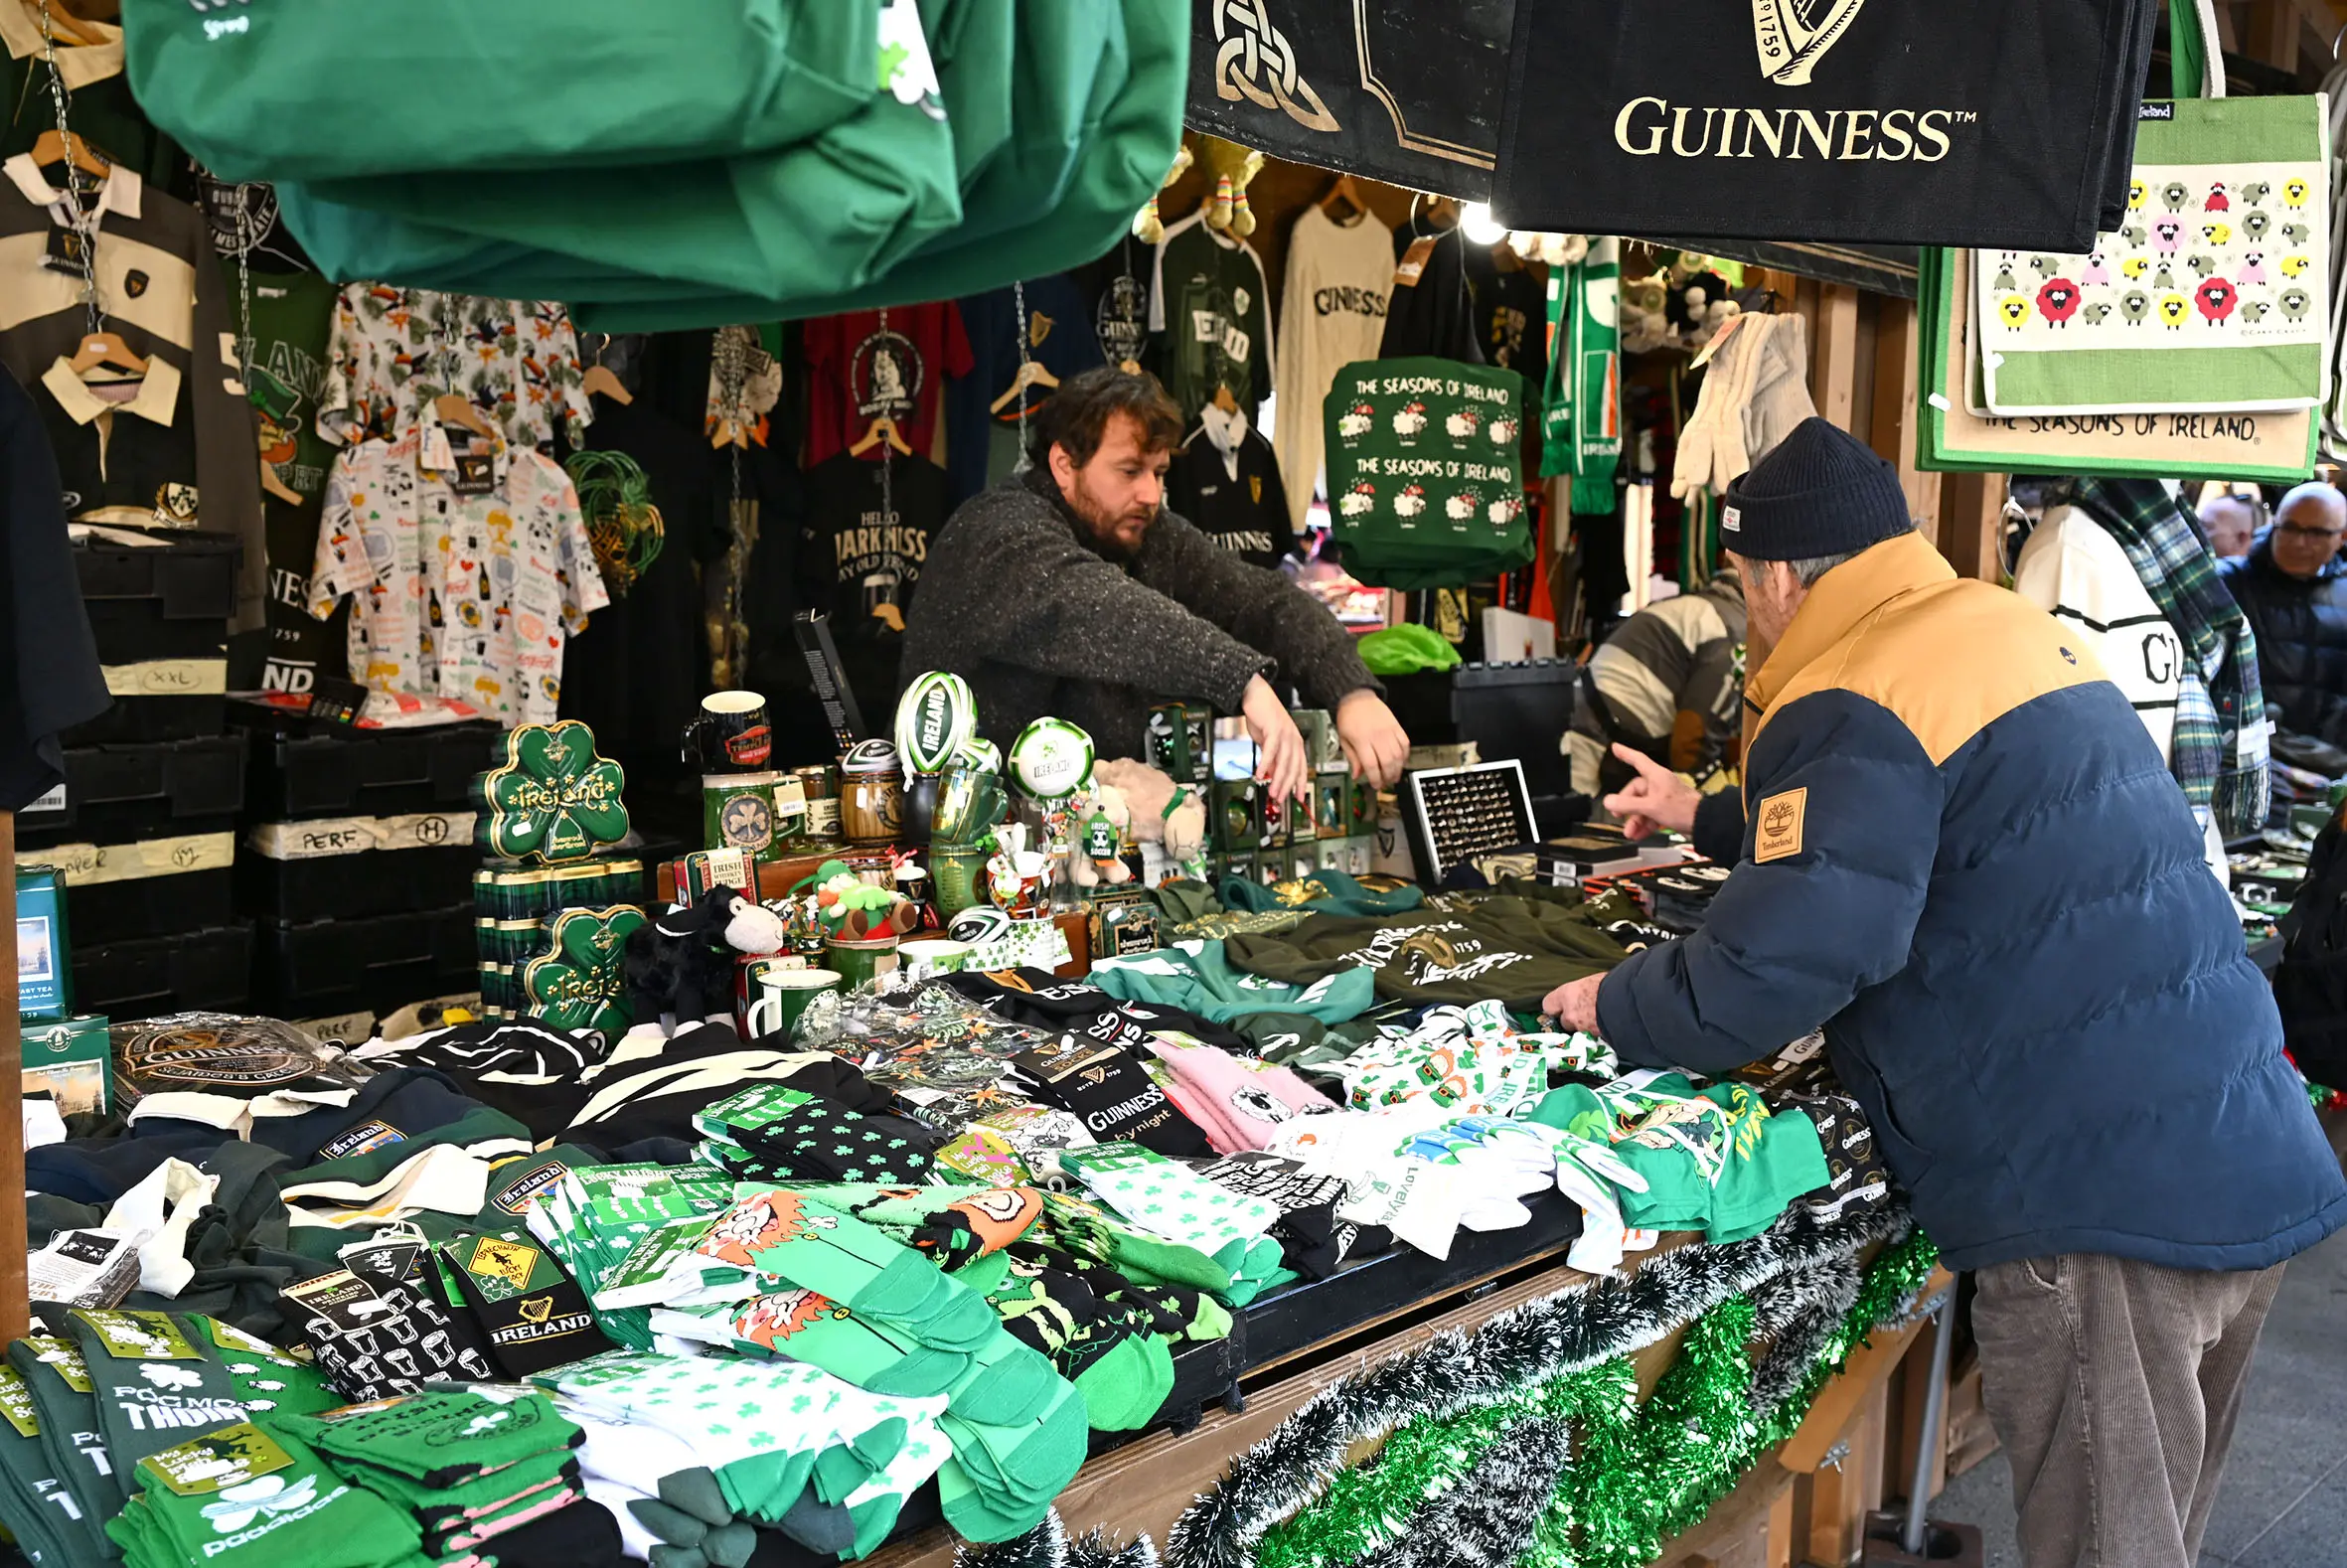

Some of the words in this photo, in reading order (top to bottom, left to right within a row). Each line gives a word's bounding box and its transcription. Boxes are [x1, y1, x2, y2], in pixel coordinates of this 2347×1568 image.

[1759, 13, 1782, 59] 1759
[1614, 96, 1952, 162] GUINNESS
[1356, 379, 1378, 394] THE
[1383, 377, 1443, 395] SEASONS
[1446, 380, 1460, 396] OF
[1464, 382, 1509, 405] IRELAND
[2029, 412, 2124, 437] SEASONS
[2135, 413, 2157, 436] OF
[2168, 413, 2257, 441] IRELAND
[1356, 458, 1378, 474] THE
[1383, 459, 1443, 477] SEASONS
[1446, 462, 1460, 478] OF
[1464, 463, 1511, 483] IRELAND
[921, 689, 946, 752] IRELAND
[1091, 822, 1111, 831] IRISH
[1090, 848, 1112, 857] SOCCER
[1762, 835, 1794, 852] Timberland
[713, 862, 742, 873] IRISH
[1452, 939, 1483, 954] 1759
[1087, 1087, 1166, 1133] GUINNESS
[1113, 1126, 1136, 1144] by
[1137, 1108, 1173, 1133] night
[329, 1125, 386, 1156] Ireland
[499, 1165, 562, 1205] Ireland
[578, 1169, 625, 1185] LUCKY
[499, 1264, 524, 1276] LUCKY
[307, 1283, 365, 1305] IRELAND
[491, 1314, 593, 1345] IRELAND
[186, 1397, 237, 1409] MO
